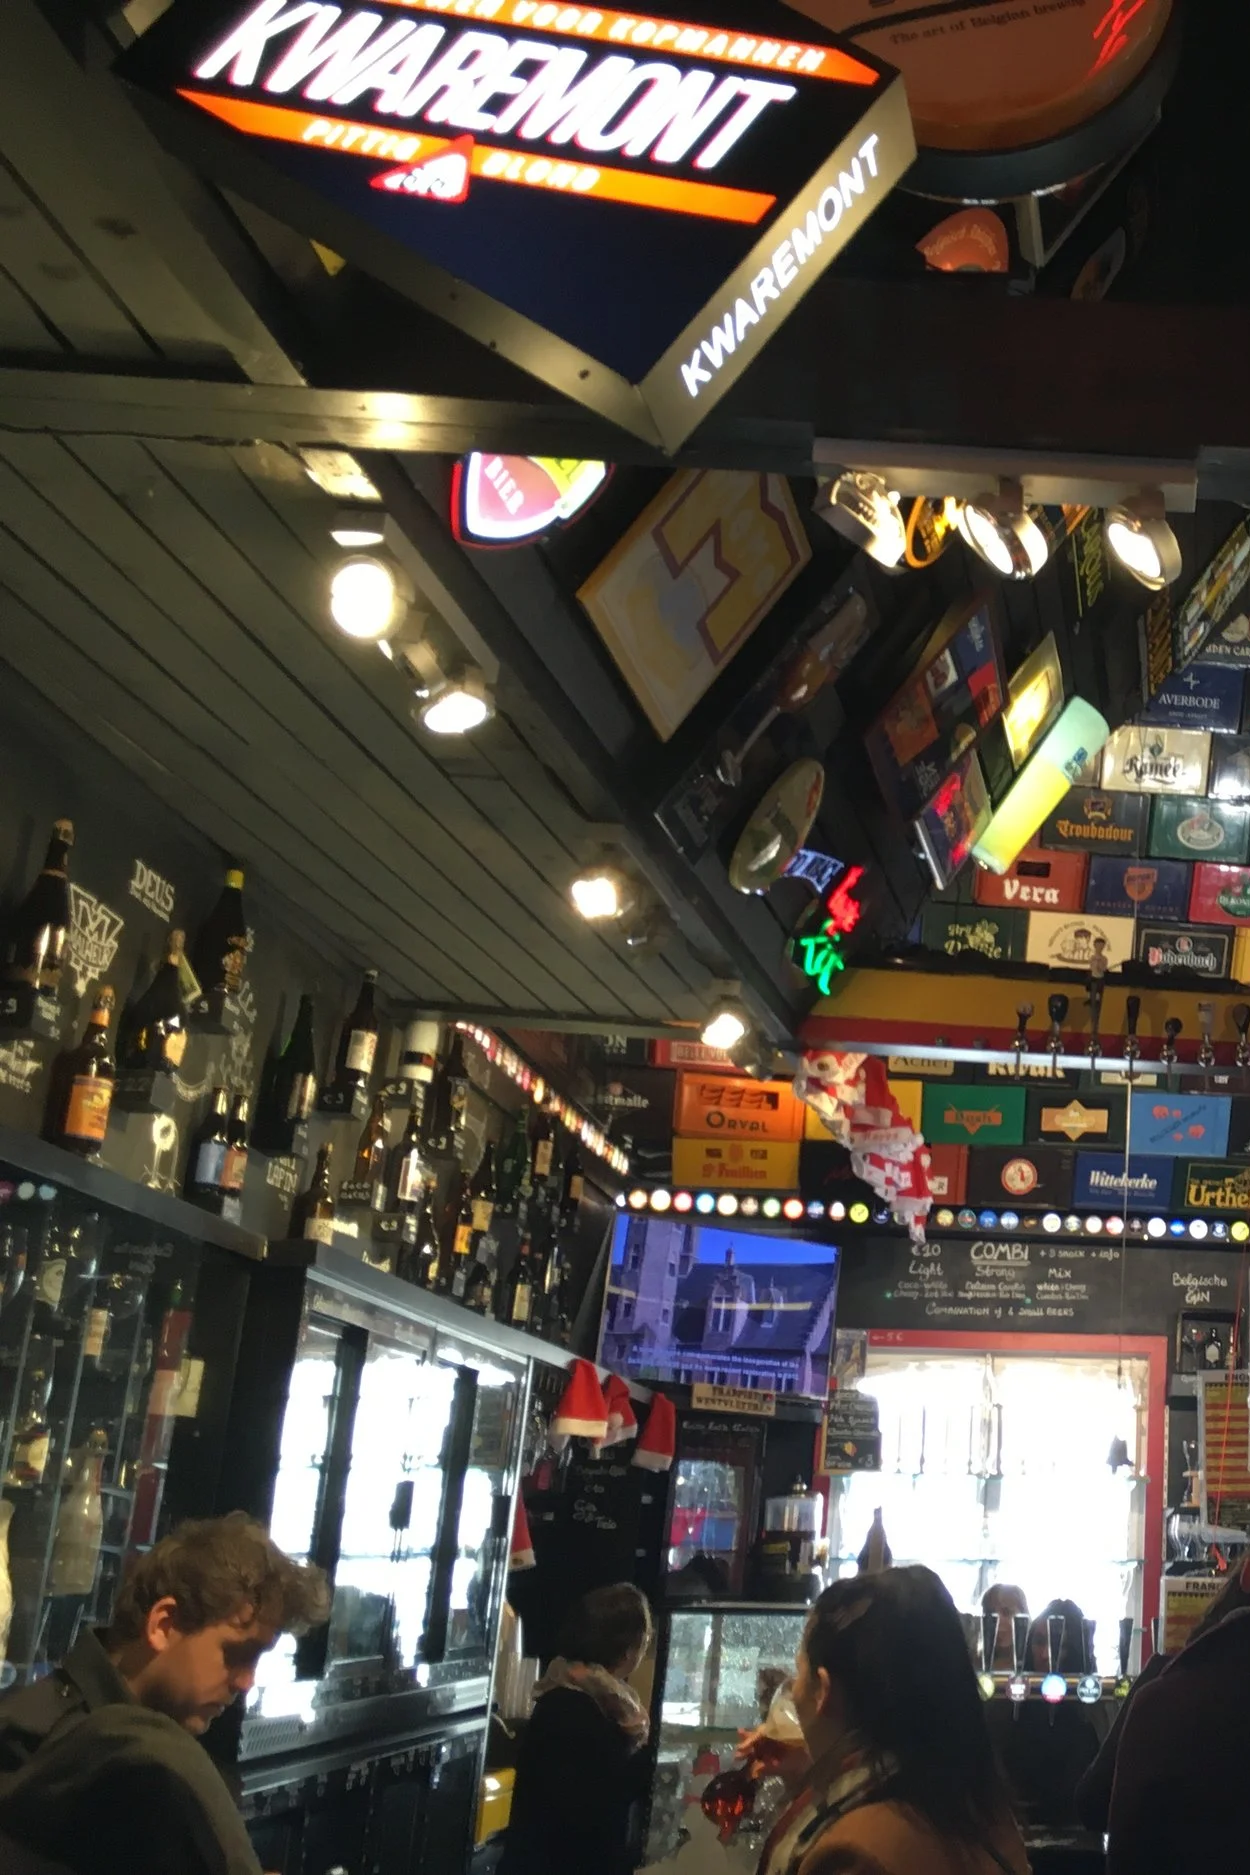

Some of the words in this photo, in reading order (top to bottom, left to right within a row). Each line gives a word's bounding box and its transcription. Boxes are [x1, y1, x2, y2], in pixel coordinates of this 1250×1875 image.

[608, 17, 826, 72] KOPMANNEN
[193, 0, 797, 170] KWAREMONT
[480, 151, 601, 191] BLOND
[681, 134, 882, 397] KWAREMONT
[484, 456, 525, 515] BIER
[1158, 693, 1221, 710] AVERBODE
[1056, 818, 1135, 842] Troubadour
[134, 858, 176, 913] DEUS
[1003, 878, 1060, 905] Vera
[705, 1110, 769, 1133] ORVAL
[1090, 1169, 1158, 1191] Wittekerke
[970, 1241, 1030, 1262] COMBI
[908, 1259, 944, 1282] Light
[974, 1265, 1017, 1282] Strong
[1048, 1267, 1073, 1279] Mix
[1172, 1272, 1228, 1288] Belgische
